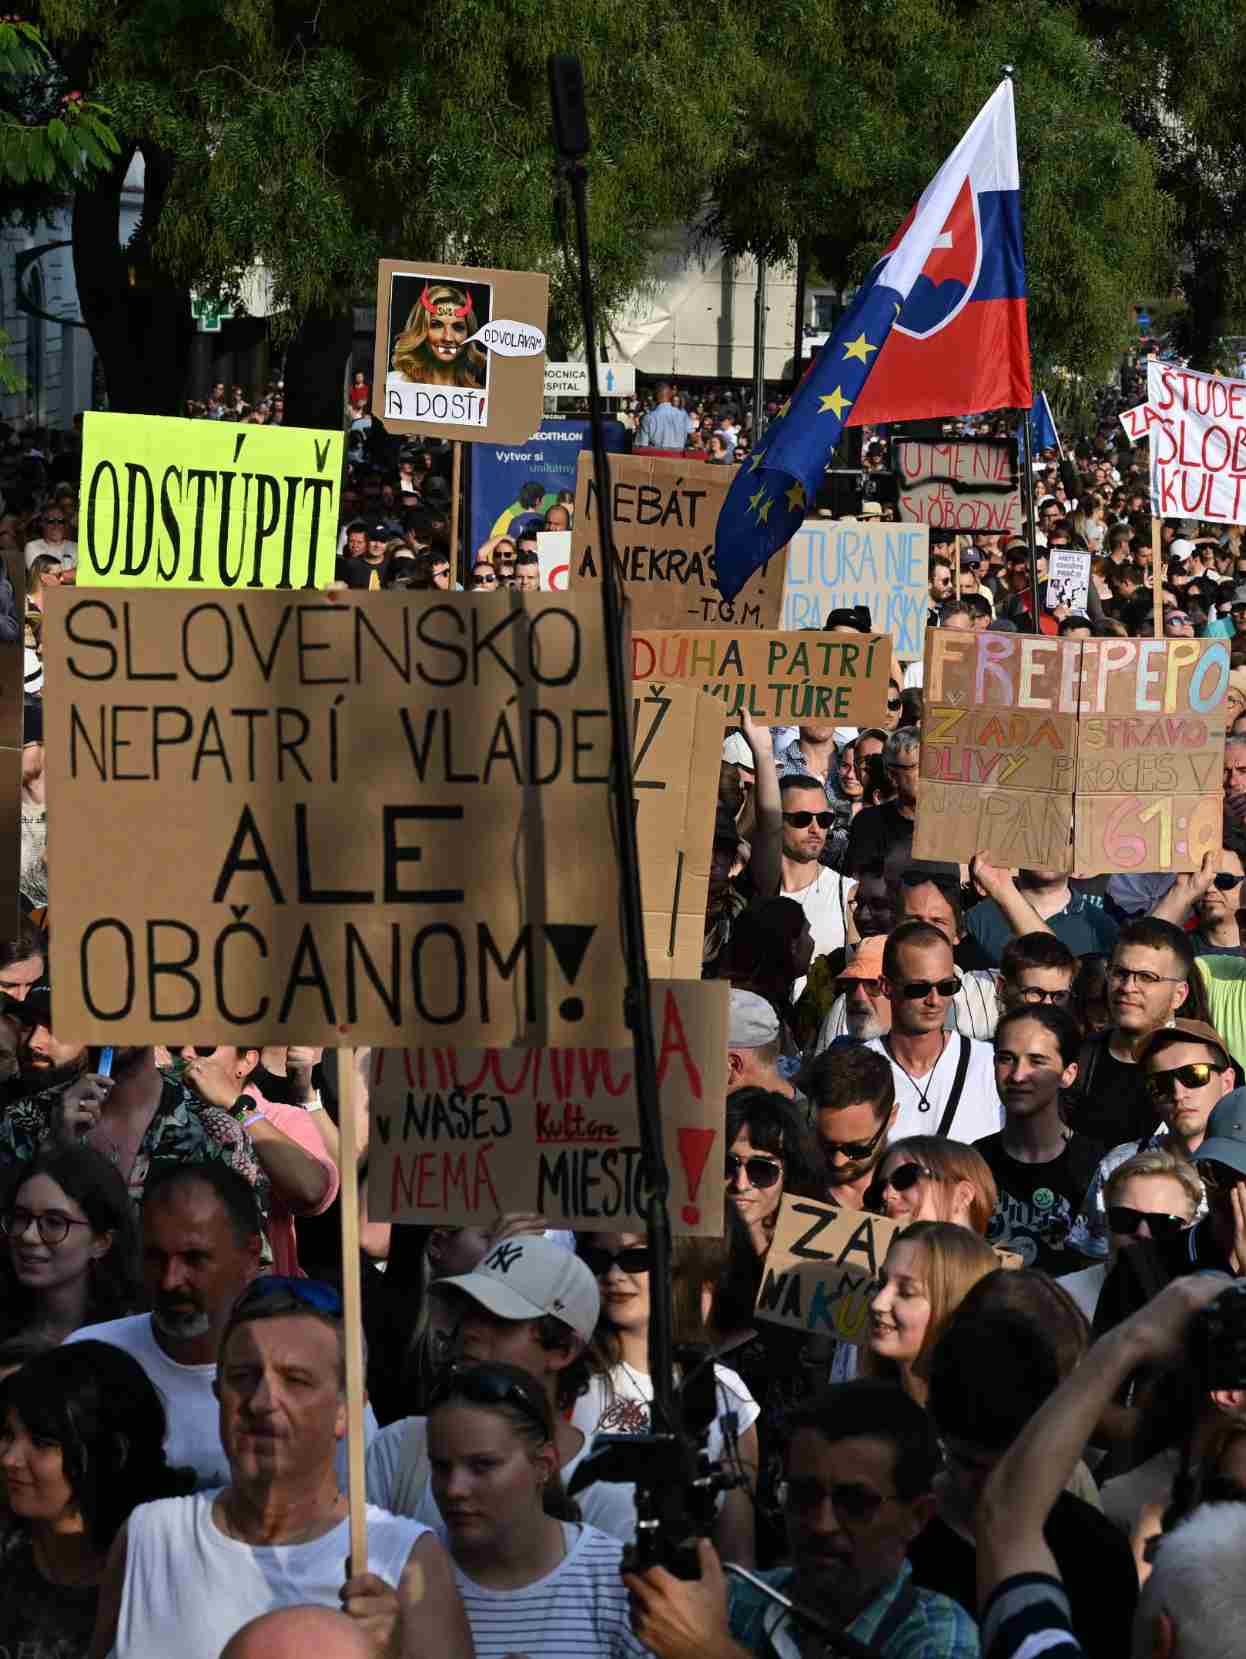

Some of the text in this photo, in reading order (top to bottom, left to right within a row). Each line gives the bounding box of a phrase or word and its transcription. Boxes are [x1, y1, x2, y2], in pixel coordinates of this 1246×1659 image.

[388, 390, 402, 415] A
[544, 382, 580, 391] SPITAL
[1123, 406, 1161, 437] ZA
[496, 451, 544, 462] Vytvor si
[86, 432, 333, 589] ODSTÚPIŤ
[63, 600, 582, 687] SLOVENSKO
[632, 633, 882, 680] DÚHA PATRÍ
[70, 694, 610, 784] NEPATRÍ VLÁDE
[1052, 752, 1179, 792] PROCES
[1189, 753, 1218, 790] V
[213, 803, 465, 904] ALE
[80, 905, 598, 1025] OBČANOM!
[402, 1086, 513, 1142] NAŠEJ
[391, 1142, 502, 1215] NEMÁ
